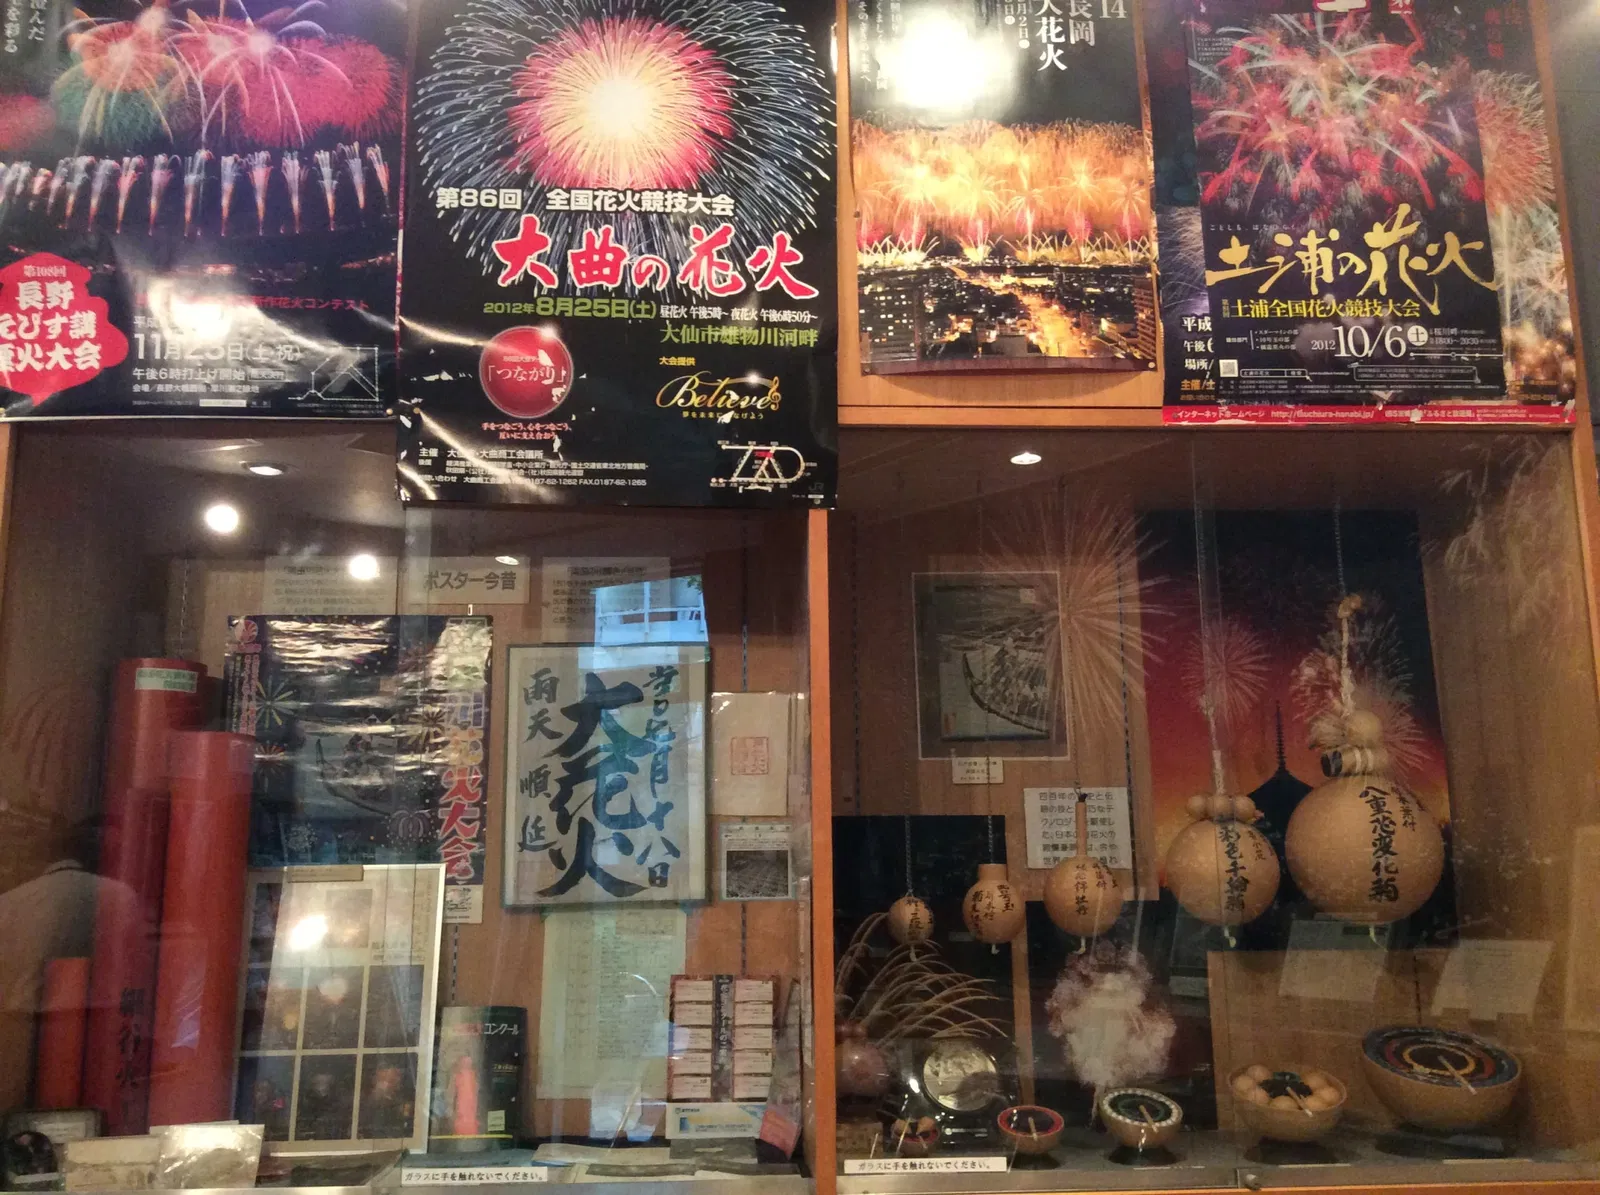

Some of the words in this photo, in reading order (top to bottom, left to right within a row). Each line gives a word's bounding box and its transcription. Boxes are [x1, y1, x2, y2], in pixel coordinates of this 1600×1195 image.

[436, 187, 522, 210] 第86回
[546, 189, 735, 216] 全国花火競技大会
[492, 214, 819, 299] 大曲の花火
[1205, 204, 1498, 315] 土浦の花火
[15, 280, 74, 310] 長野
[483, 297, 657, 319] 2012年8月25日(土)
[1230, 299, 1420, 318] 土浦全国花火競技大会
[1181, 316, 1212, 332] 平成
[659, 325, 819, 347] 大仙市雄物川河畔
[1311, 340, 1335, 350] 2012
[1333, 325, 1407, 358] 10/6
[656, 371, 775, 410] Believe
[423, 570, 517, 591] ポスター今昔
[483, 1022, 520, 1036] コンクール
[404, 1171, 545, 1182] ガラスに手を触れないでください。
[858, 1160, 994, 1172] ガラスに手を触れないでください。
